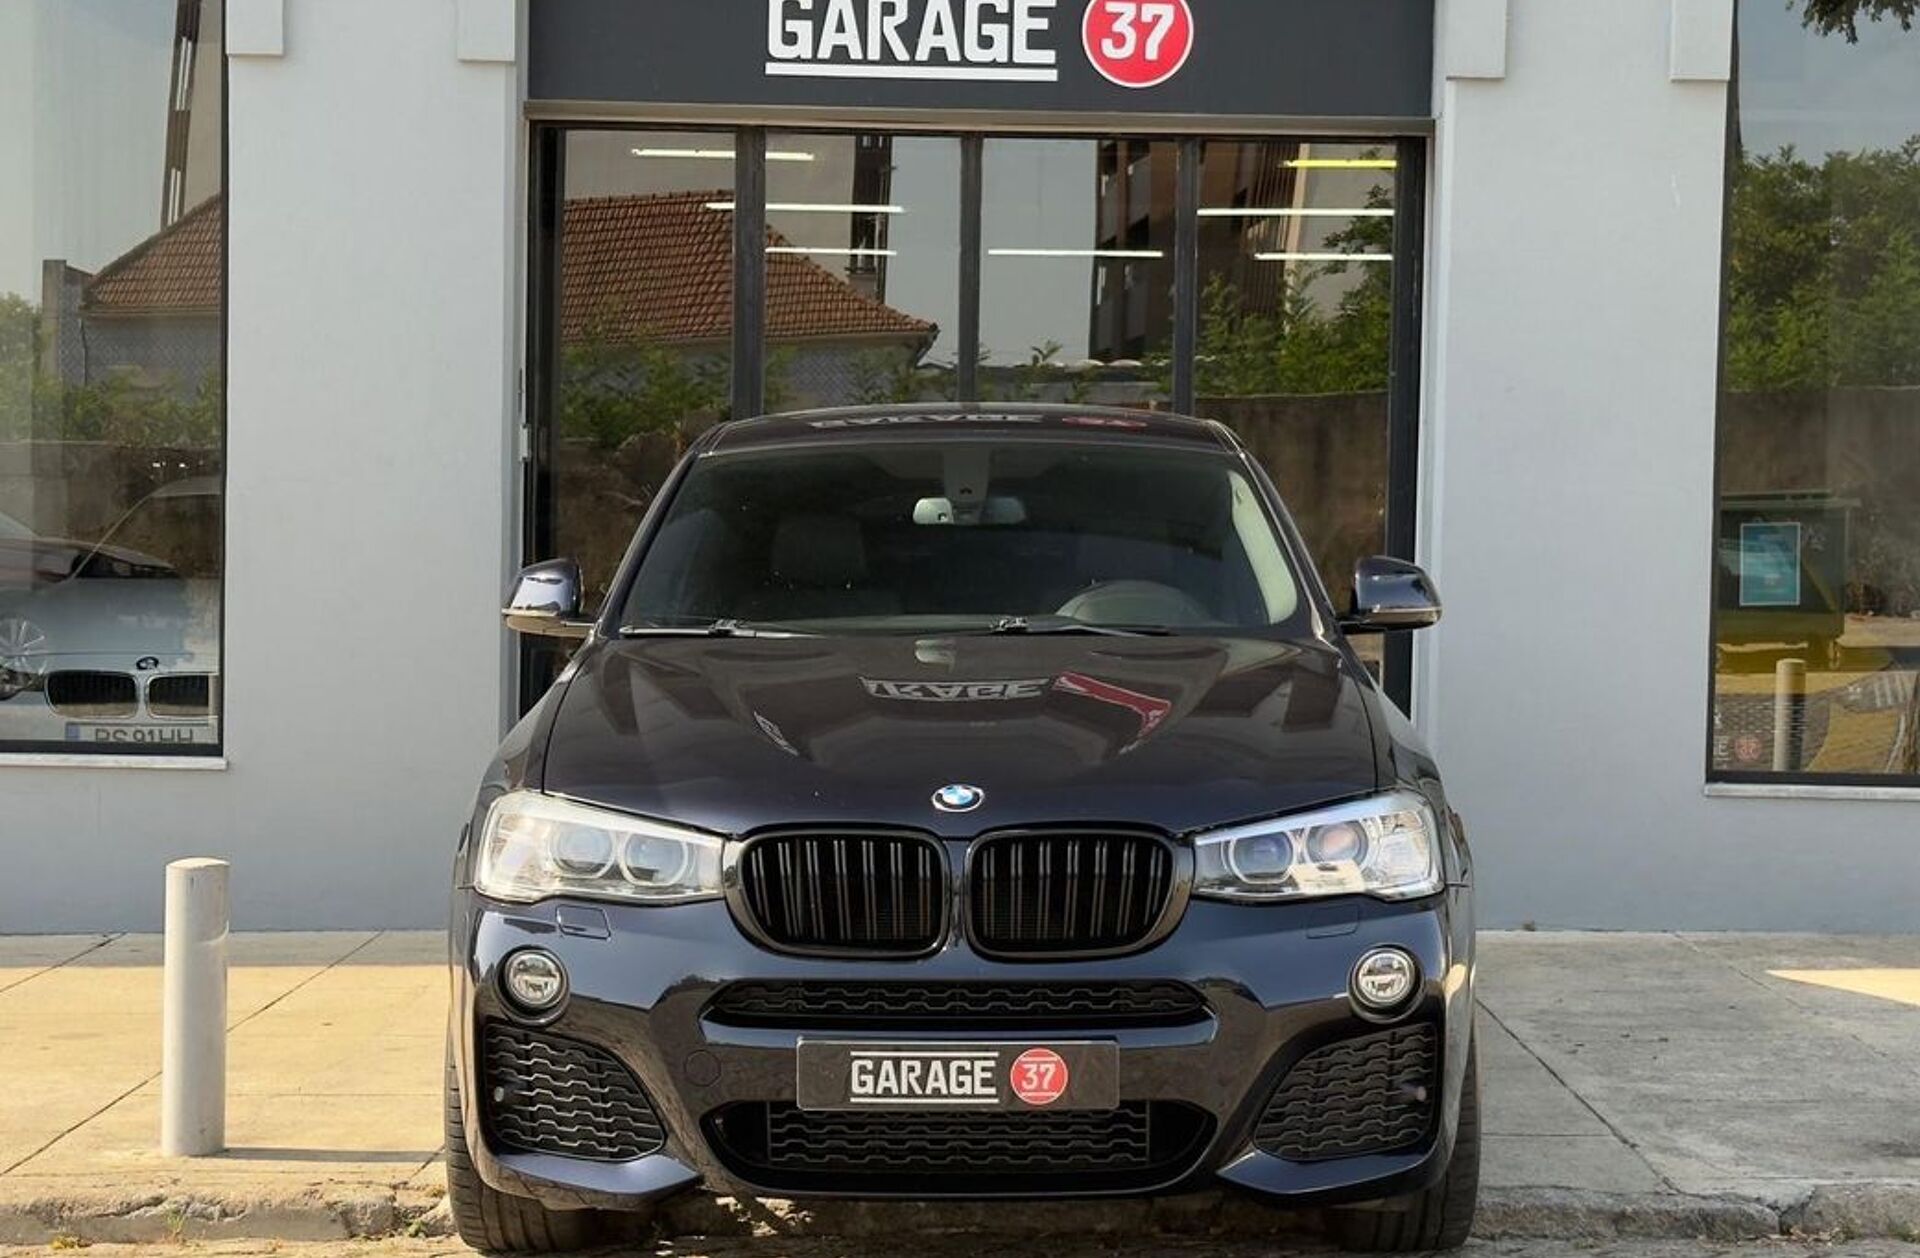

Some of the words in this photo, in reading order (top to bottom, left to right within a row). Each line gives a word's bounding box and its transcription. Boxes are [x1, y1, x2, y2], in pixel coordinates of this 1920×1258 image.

[767, 0, 1057, 64] GARAGE
[1101, 2, 1175, 60] 37
[851, 1059, 997, 1095] GARAGE
[1021, 1063, 1056, 1090] 37
